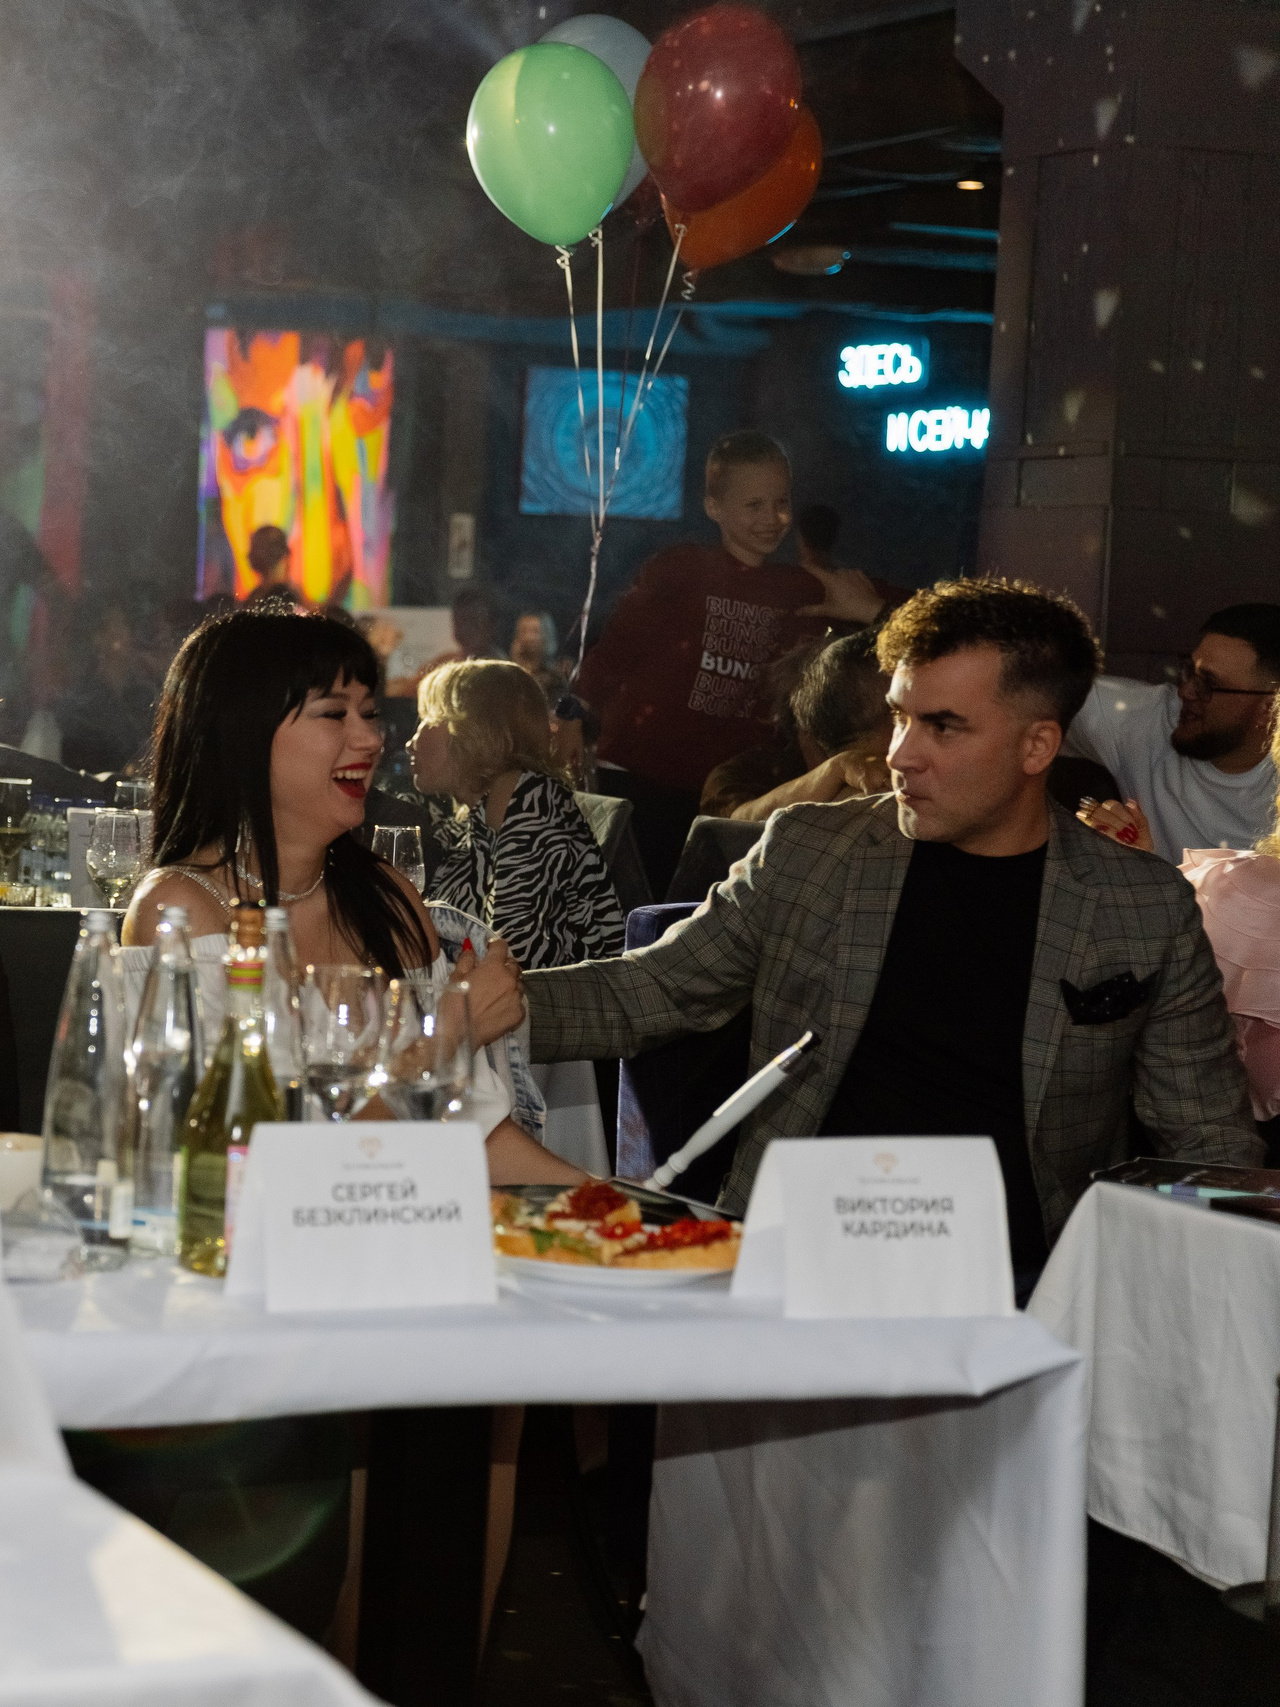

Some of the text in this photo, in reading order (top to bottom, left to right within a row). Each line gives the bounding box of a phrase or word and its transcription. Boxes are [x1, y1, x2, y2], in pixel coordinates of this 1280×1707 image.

[837, 342, 923, 389] ЗДЕСЬ
[330, 1176, 419, 1202] СЕРГЕЙ
[291, 1200, 463, 1227] БЕЗКЛИНСКИЙ
[834, 1196, 955, 1215] ВИКТОРИЯ
[841, 1220, 952, 1240] КАРДИНА
